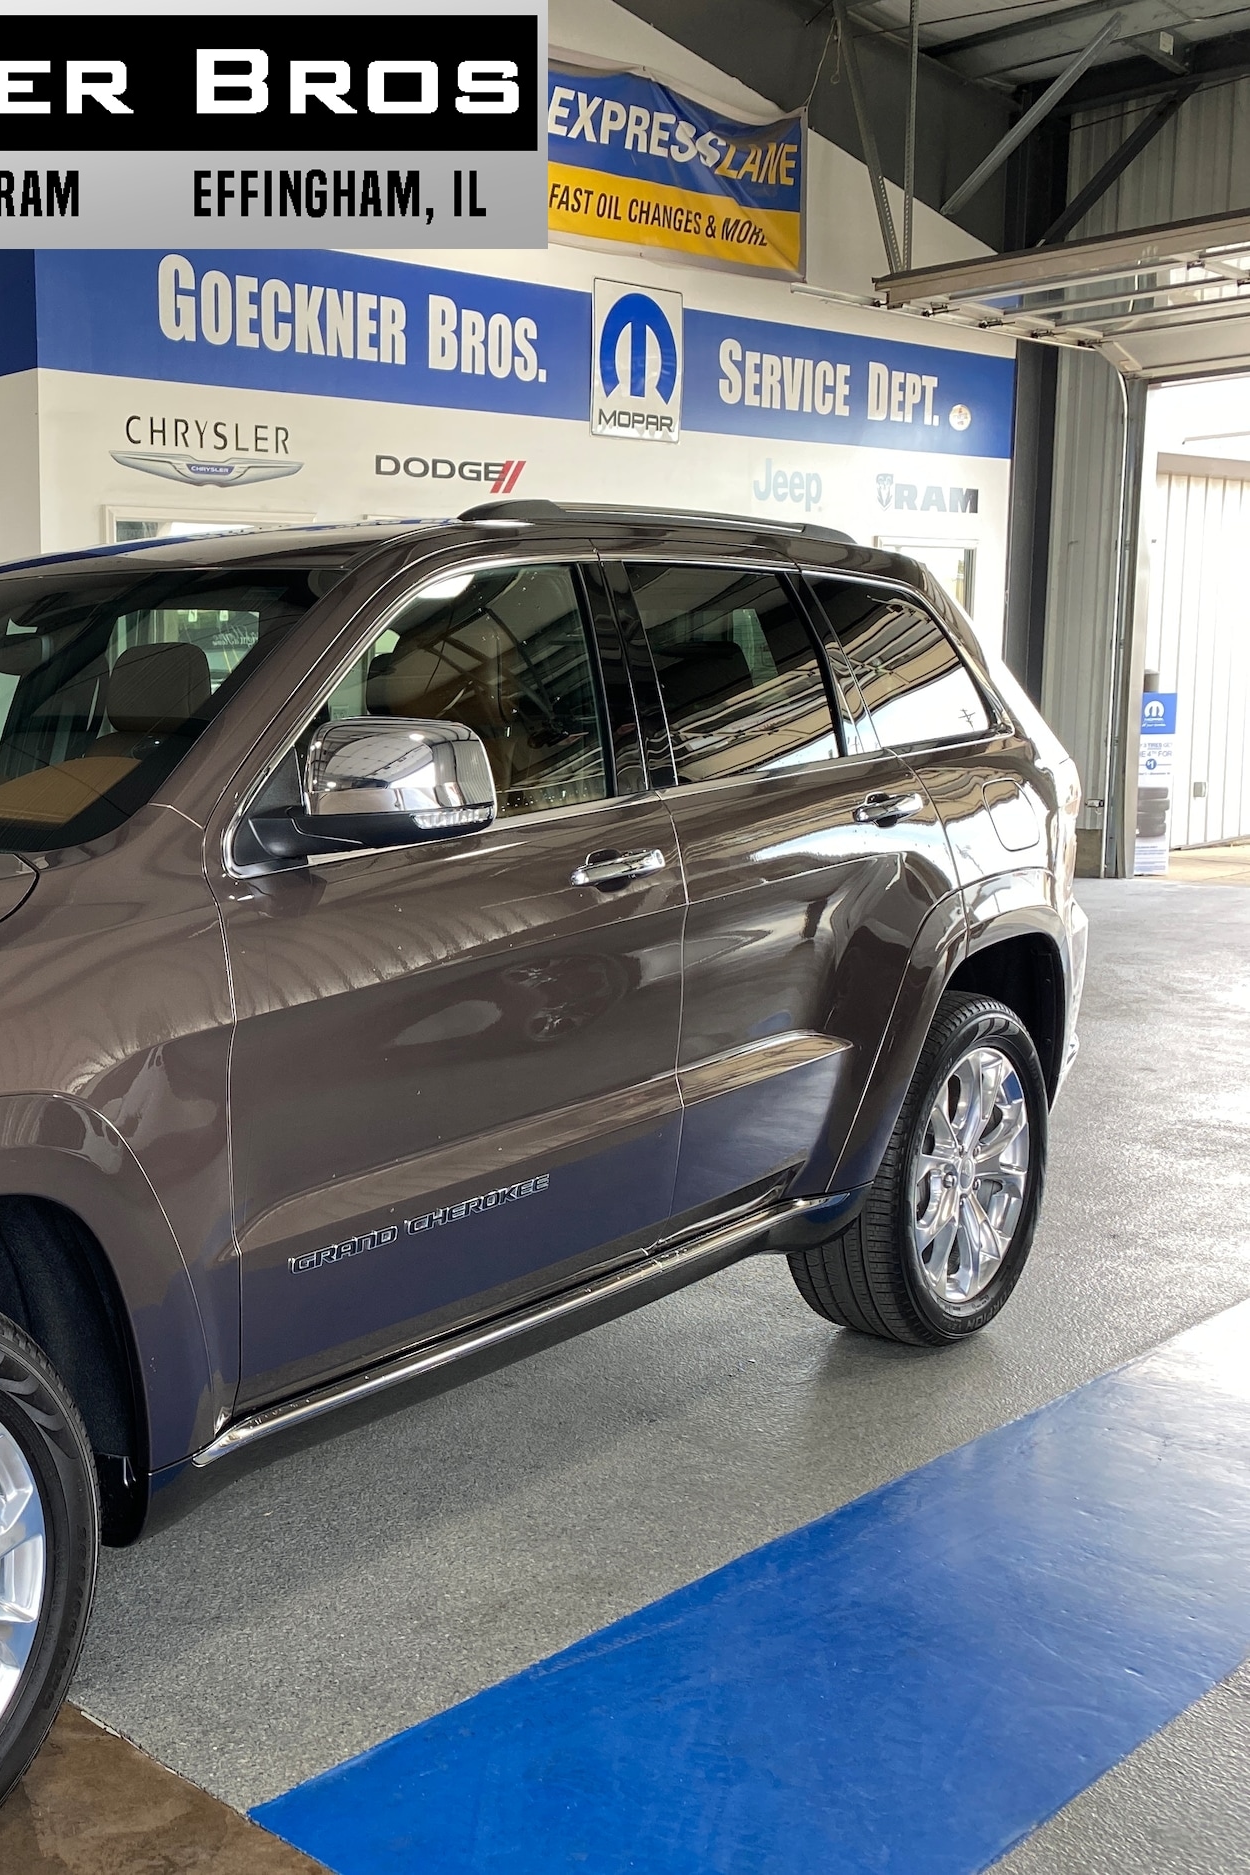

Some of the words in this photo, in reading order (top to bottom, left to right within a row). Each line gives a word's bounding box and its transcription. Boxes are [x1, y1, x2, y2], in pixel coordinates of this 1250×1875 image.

[548, 182, 594, 214] FAST
[596, 193, 622, 220] OIL
[628, 198, 702, 235] CHANGES
[705, 214, 716, 239] &
[157, 252, 407, 366] GOECKNER
[427, 293, 548, 384] BROS.
[718, 337, 851, 418] SERVICE
[866, 361, 940, 427] DEPT.
[124, 414, 290, 455] CHRYSLER
[597, 408, 674, 433] MOPAR
[190, 464, 230, 474] CHRYSLER
[374, 454, 507, 483] DODGE
[752, 457, 823, 513] Jeep
[893, 482, 980, 515] RAM
[287, 1224, 399, 1275] GRAND
[403, 1173, 550, 1236] CHEROKEE
